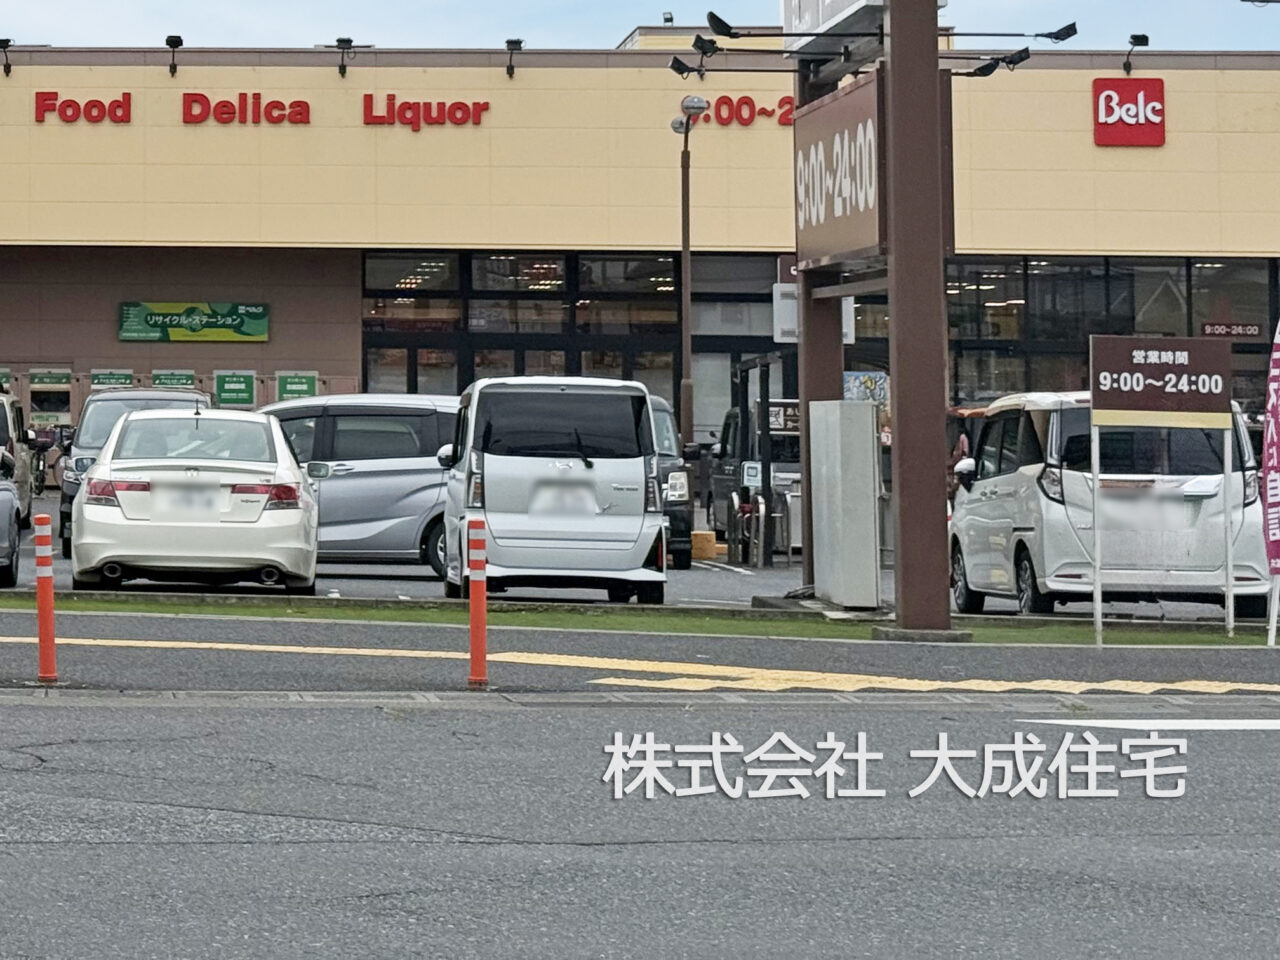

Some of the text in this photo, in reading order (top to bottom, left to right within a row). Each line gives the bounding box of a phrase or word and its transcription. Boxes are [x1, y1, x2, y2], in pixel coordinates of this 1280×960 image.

[35, 91, 489, 132] Food Delica Liquor
[1098, 90, 1163, 125] Belc
[1131, 350, 1189, 365] 営業時間
